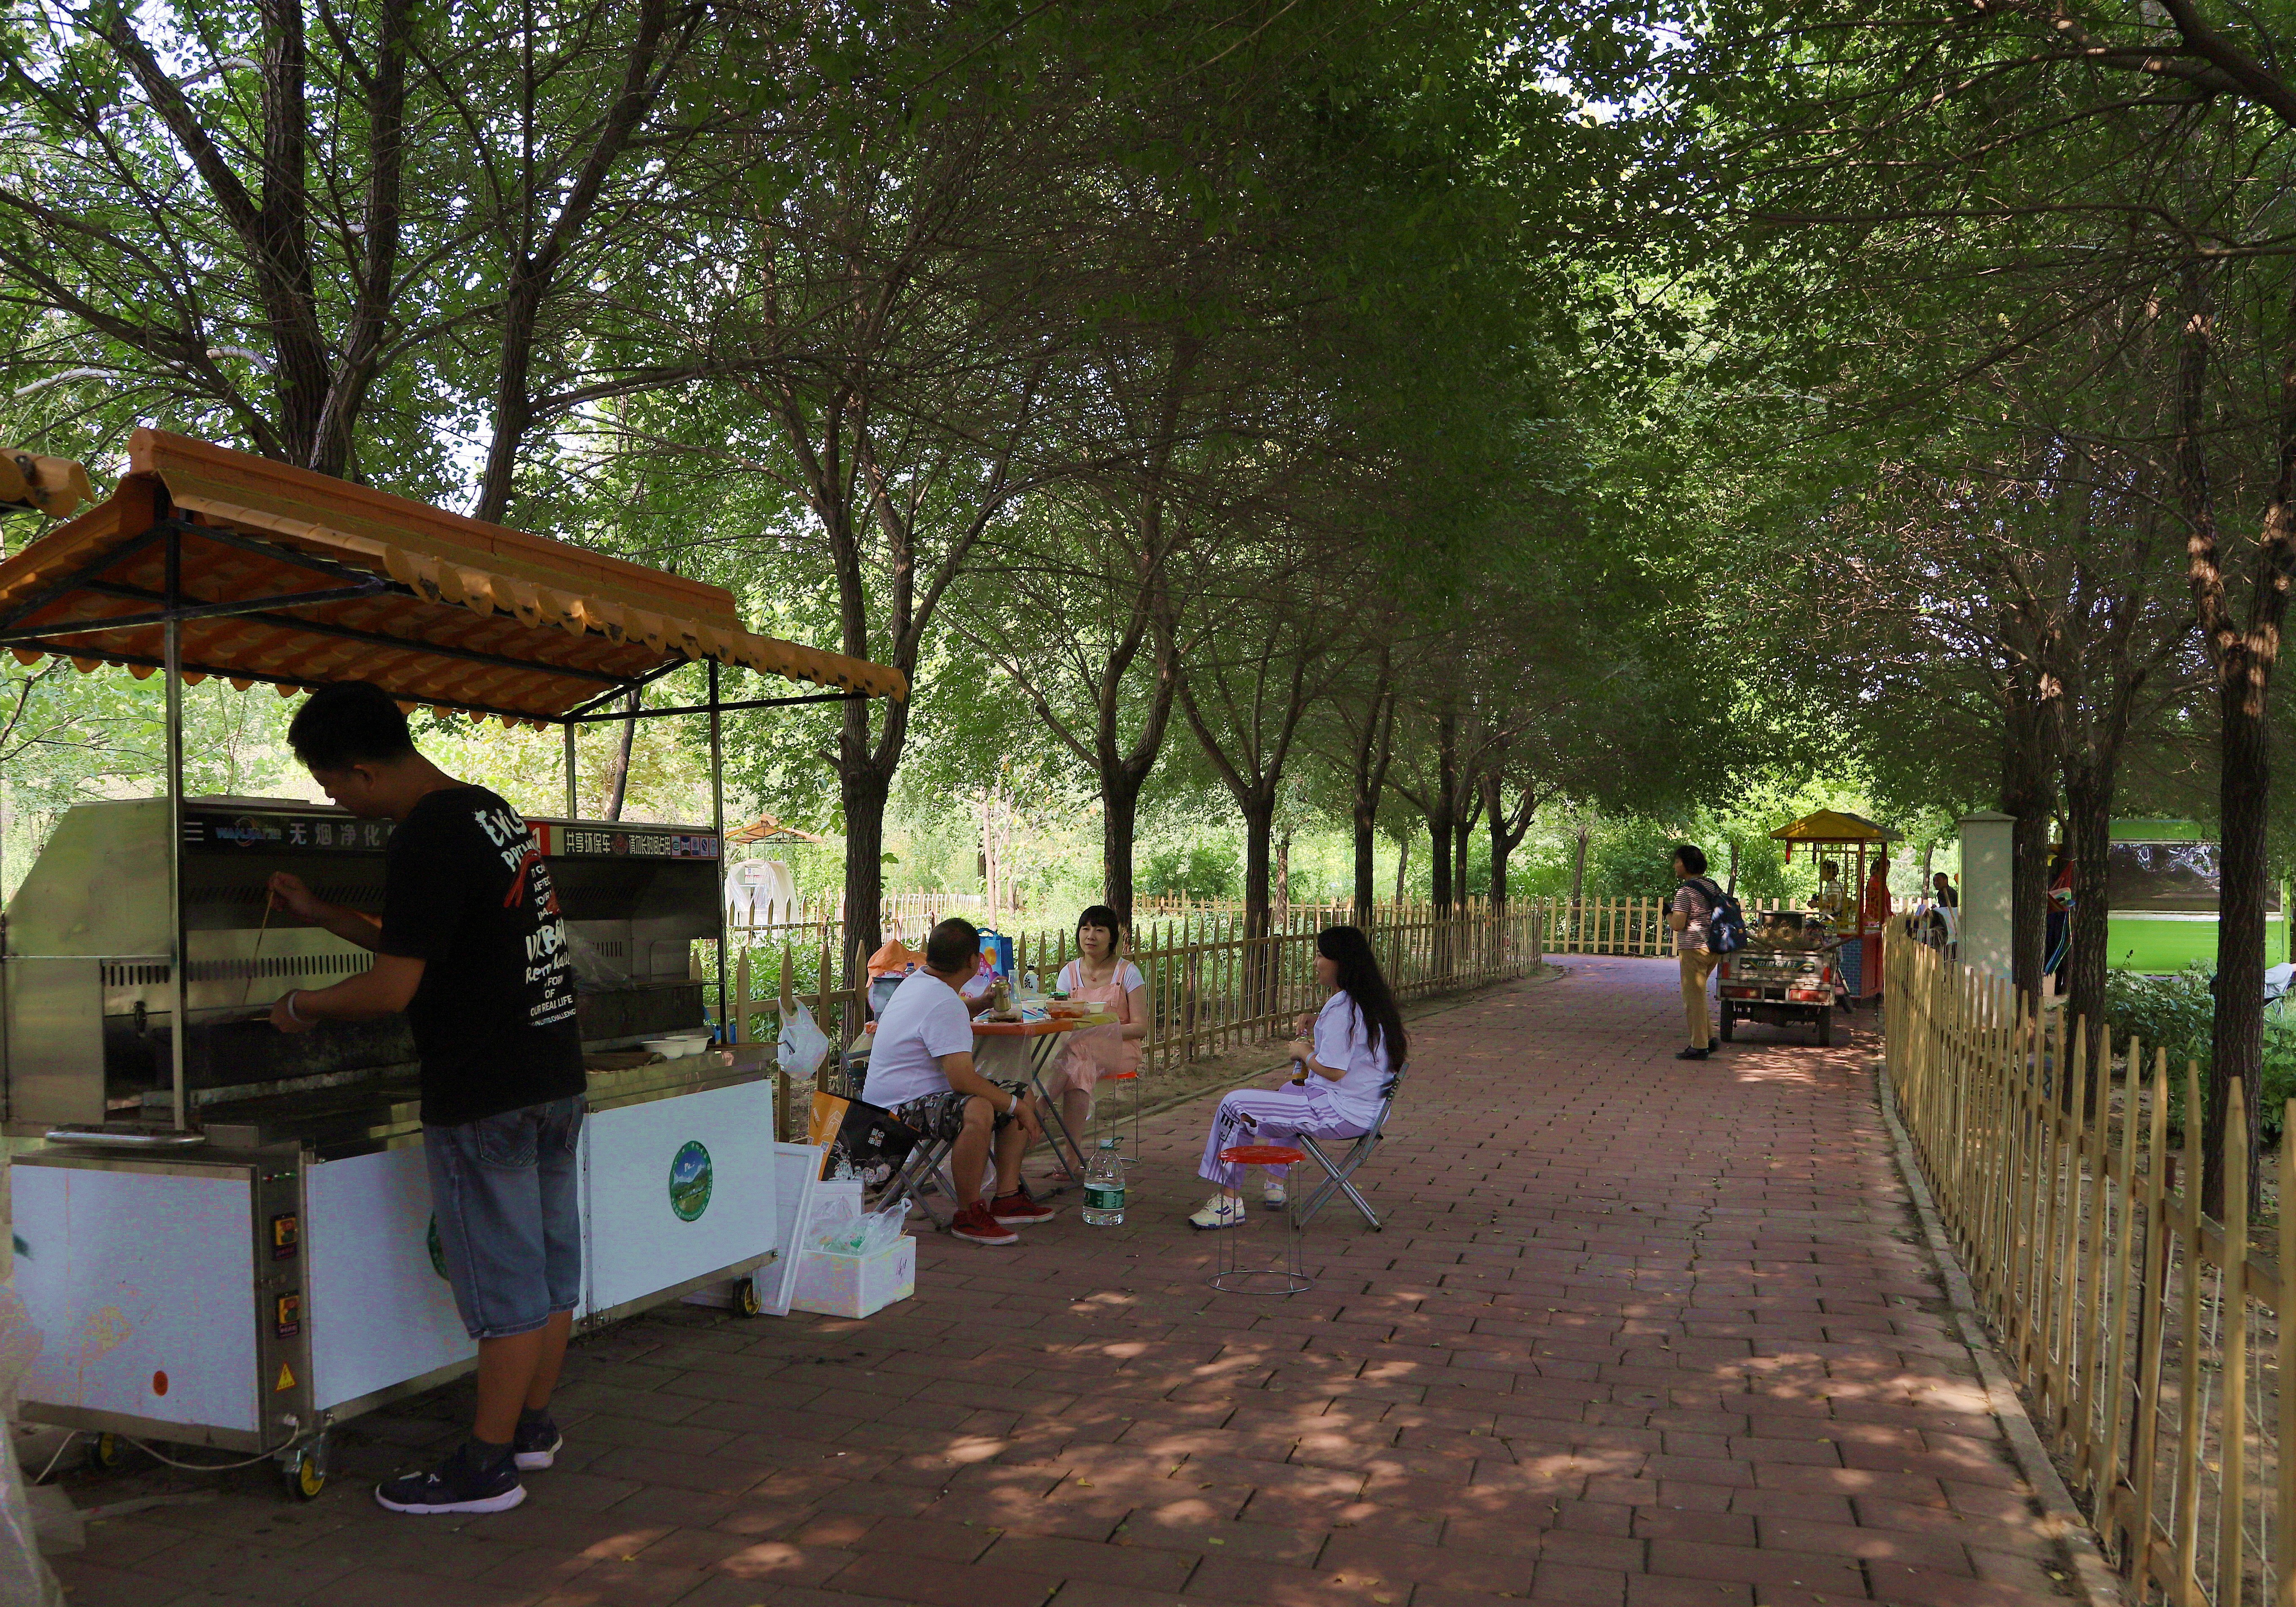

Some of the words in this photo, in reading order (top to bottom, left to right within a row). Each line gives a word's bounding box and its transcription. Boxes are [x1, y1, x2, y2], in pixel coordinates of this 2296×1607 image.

[289, 823, 396, 846] 无烟净化
[566, 832, 610, 853] 共享环保车
[629, 834, 671, 856] 请勿长时间占用
[530, 1004, 543, 1017] OUR
[542, 999, 559, 1013] REAL
[558, 994, 573, 1007] LIFE
[544, 989, 556, 999] OF
